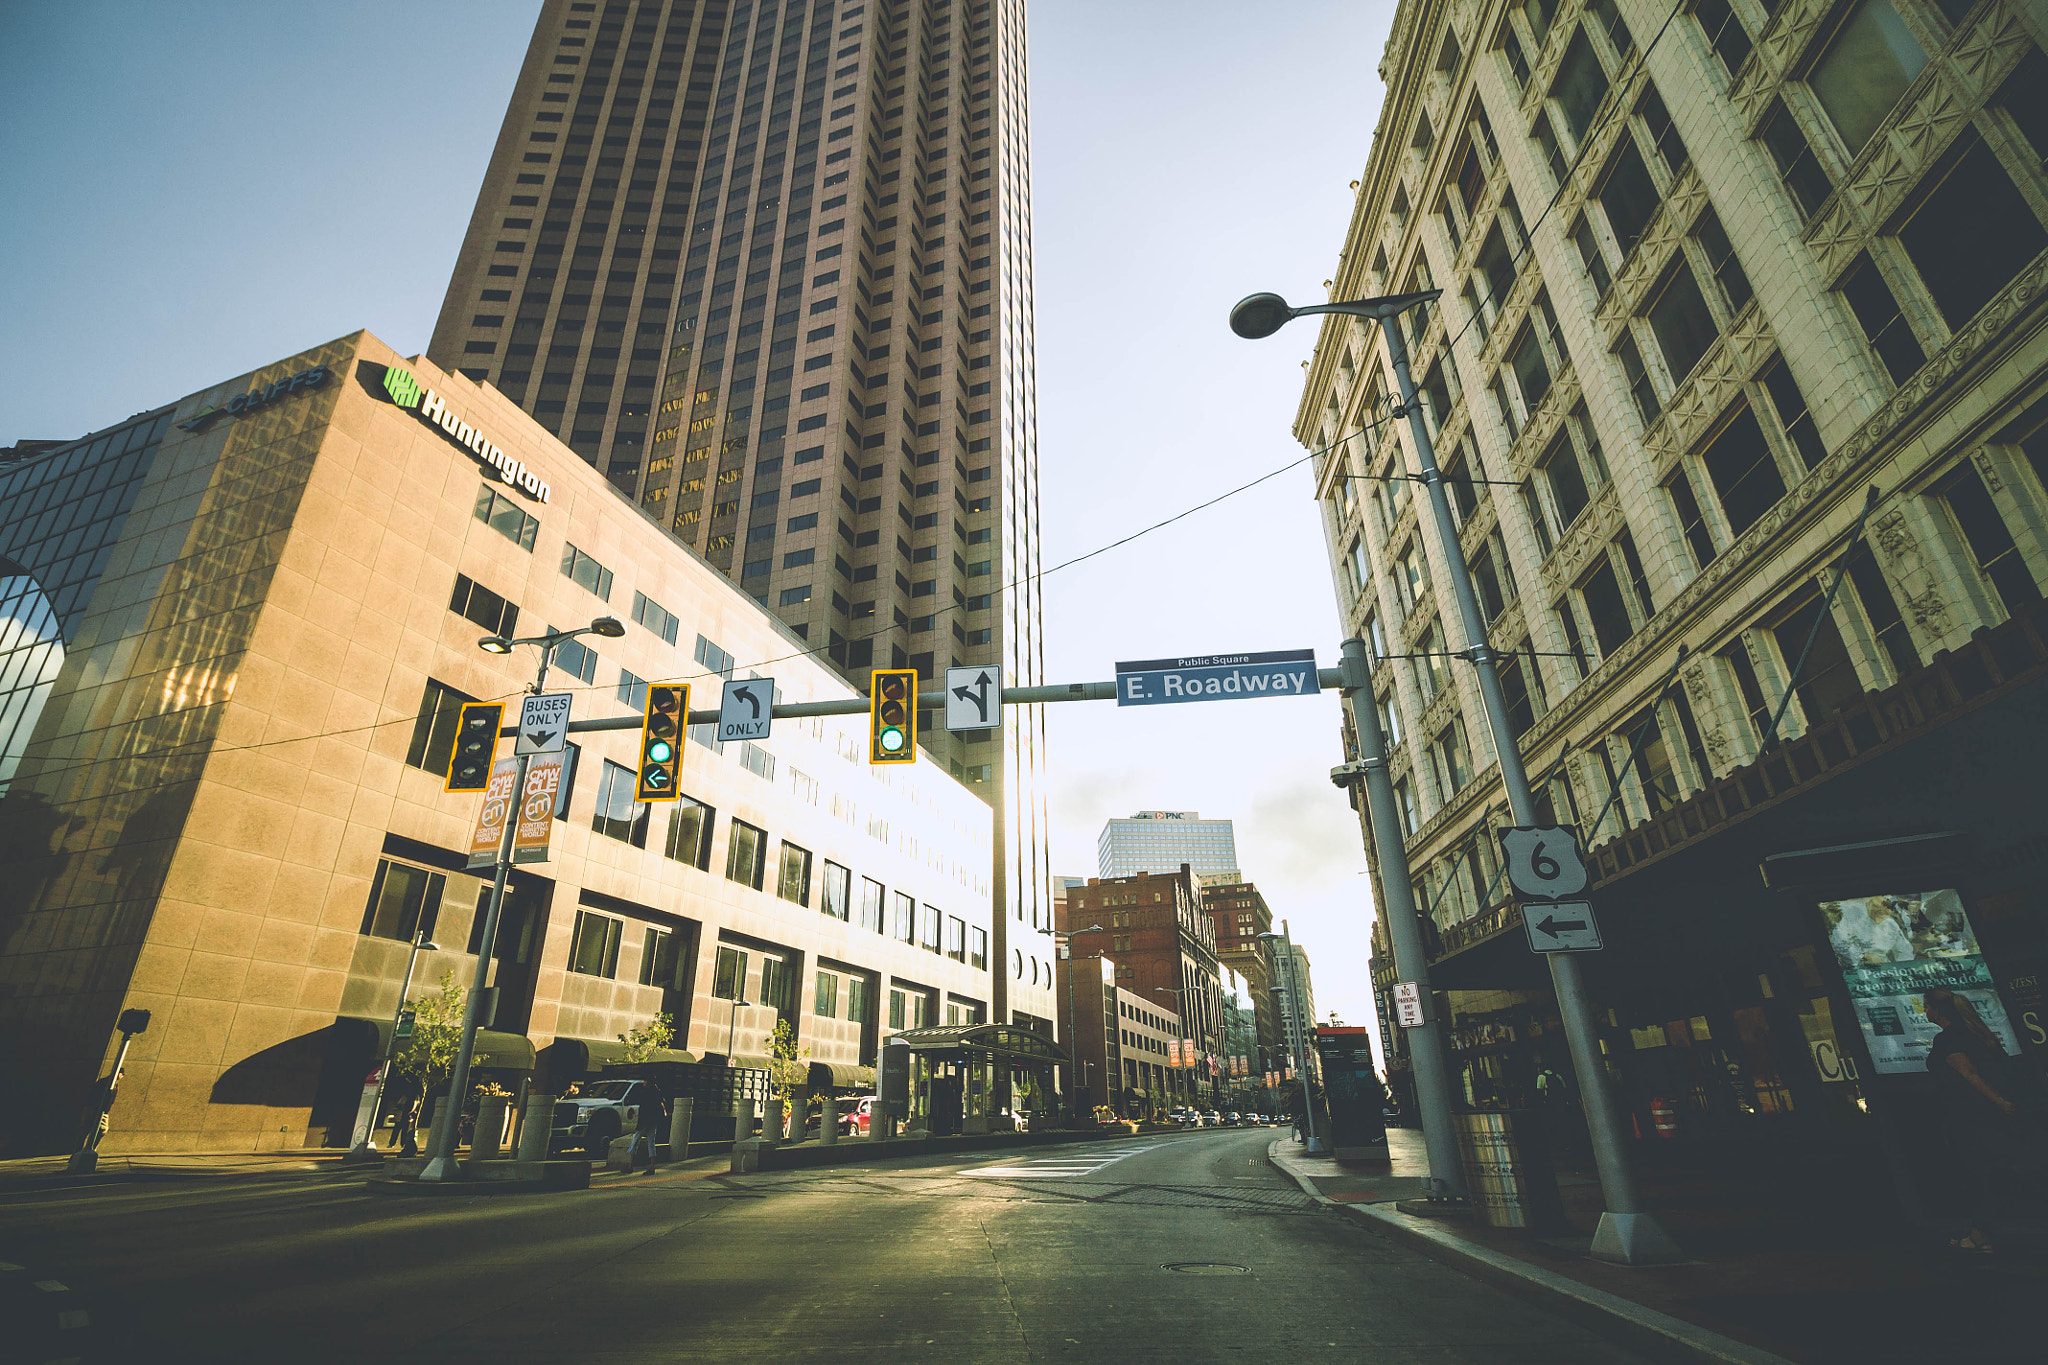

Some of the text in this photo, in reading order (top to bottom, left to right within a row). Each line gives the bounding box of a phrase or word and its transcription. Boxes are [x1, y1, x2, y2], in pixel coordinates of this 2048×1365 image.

[227, 366, 326, 414] CLIFFS
[421, 388, 551, 503] Huntington
[1178, 655, 1249, 667] Public Square
[1126, 670, 1306, 699] E. Roadway
[526, 697, 568, 713] BUSES
[526, 712, 563, 726] ONLY
[726, 721, 764, 736] ONLY
[527, 781, 557, 795] CLE
[1165, 812, 1185, 820] PNC
[1531, 840, 1561, 881] 6
[1949, 961, 1965, 973] in
[1855, 974, 1935, 993] everything
[1935, 975, 1958, 987] we
[1397, 996, 1418, 1004] PARKING
[1401, 988, 1411, 997] NO
[1379, 1018, 1392, 1059] BLUES
